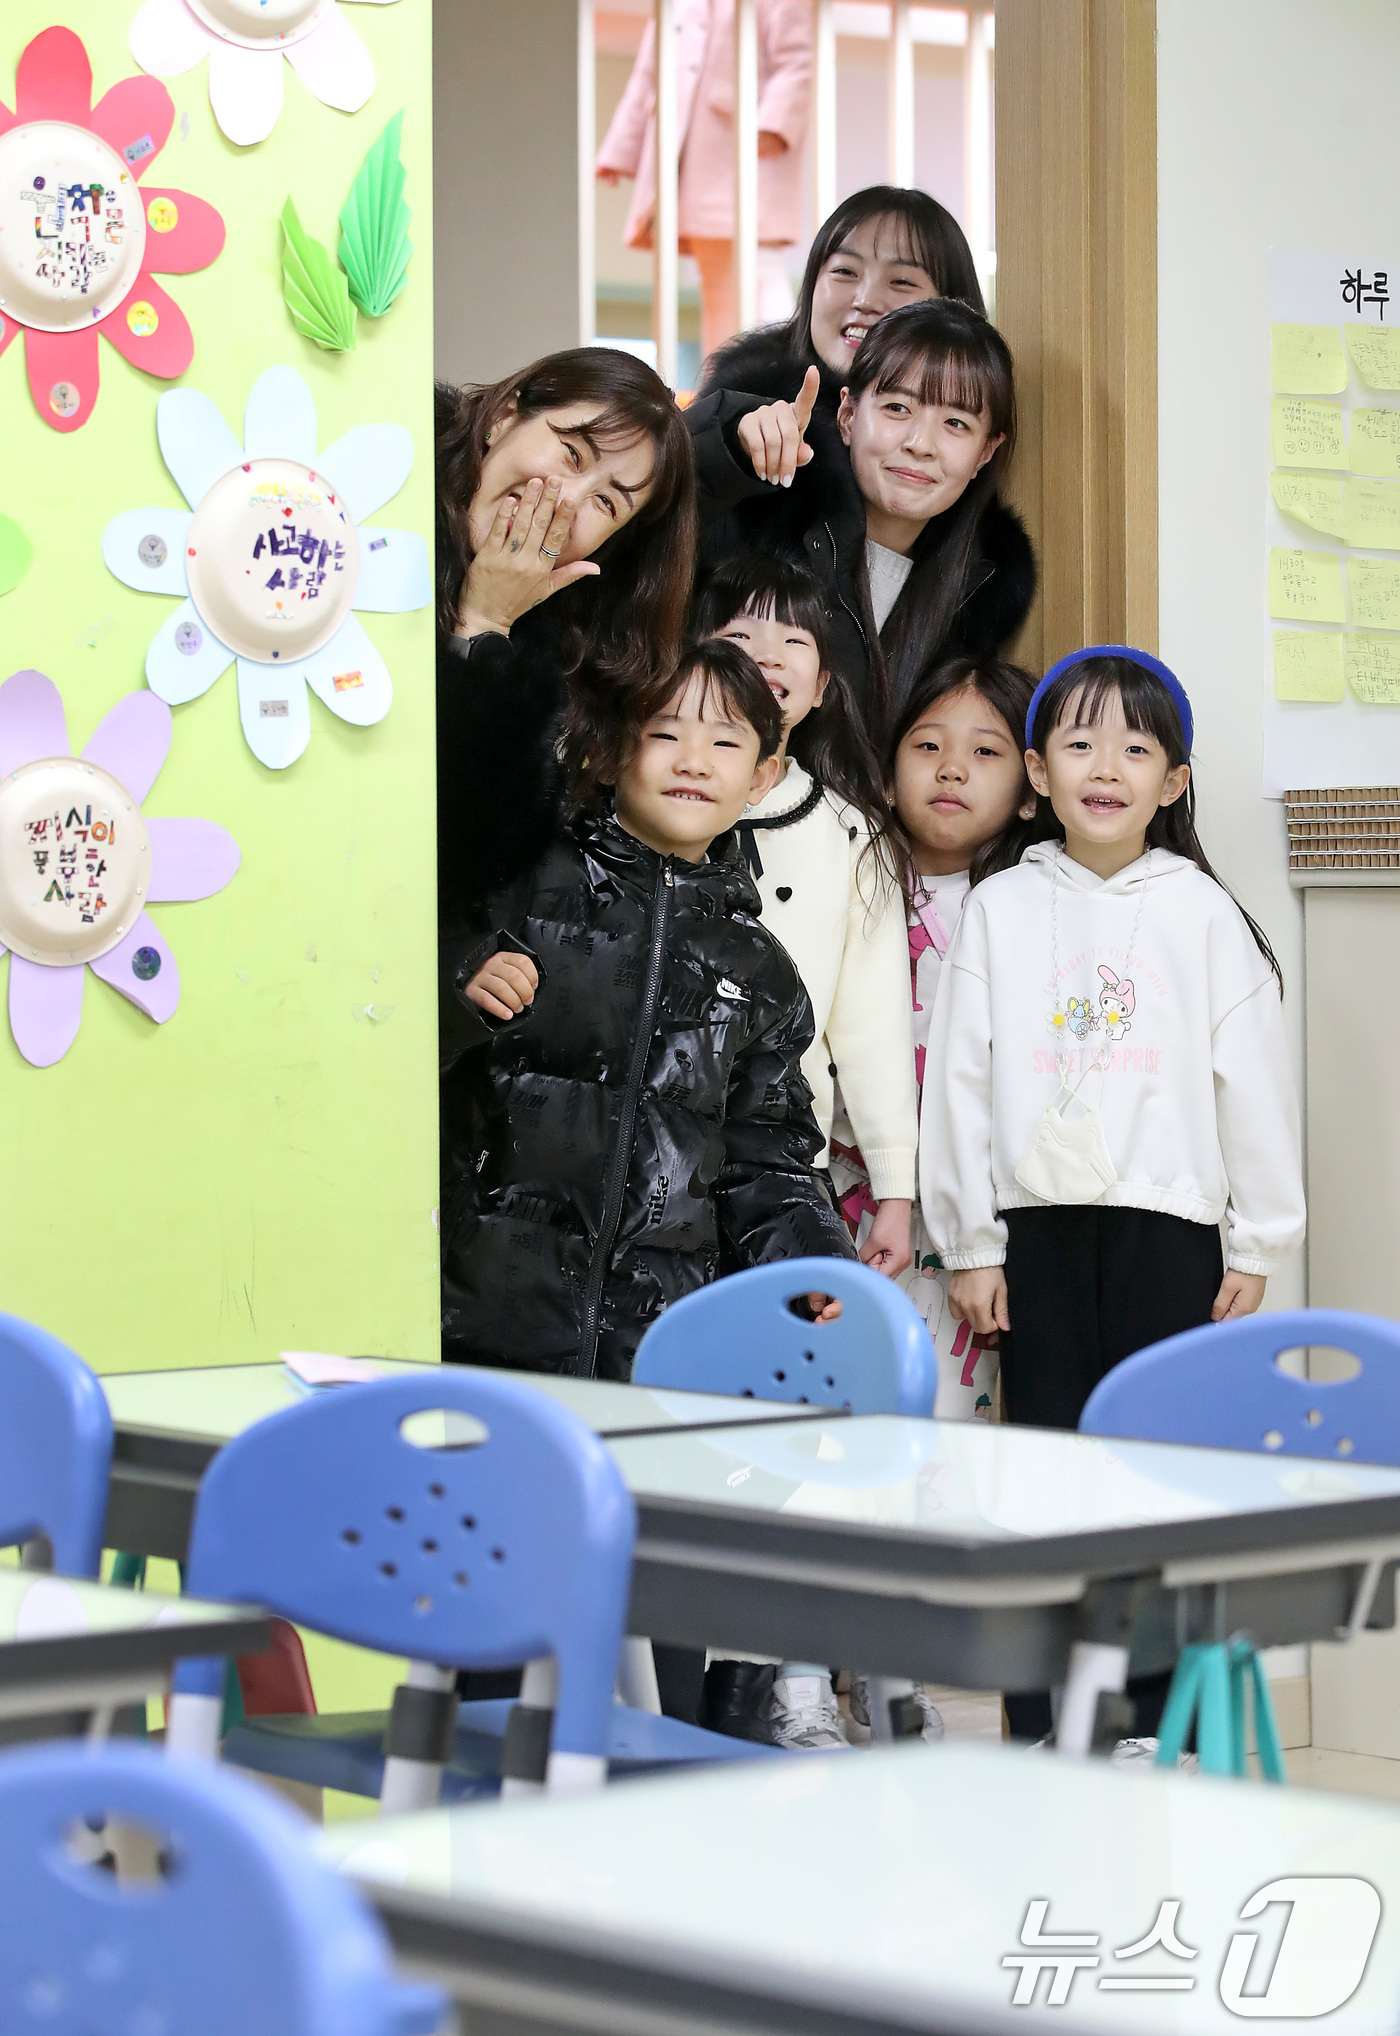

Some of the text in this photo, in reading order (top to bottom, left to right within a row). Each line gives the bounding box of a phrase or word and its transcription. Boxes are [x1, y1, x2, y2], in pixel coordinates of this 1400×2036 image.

[1340, 268, 1390, 321] 하루
[252, 524, 346, 571] 사고하는
[265, 567, 327, 599] 사람
[43, 878, 108, 923] 사람
[721, 977, 742, 996] NIKE
[1043, 951, 1086, 995] EVRYDAY
[1034, 1048, 1085, 1074] SWET
[649, 1174, 669, 1225] nike
